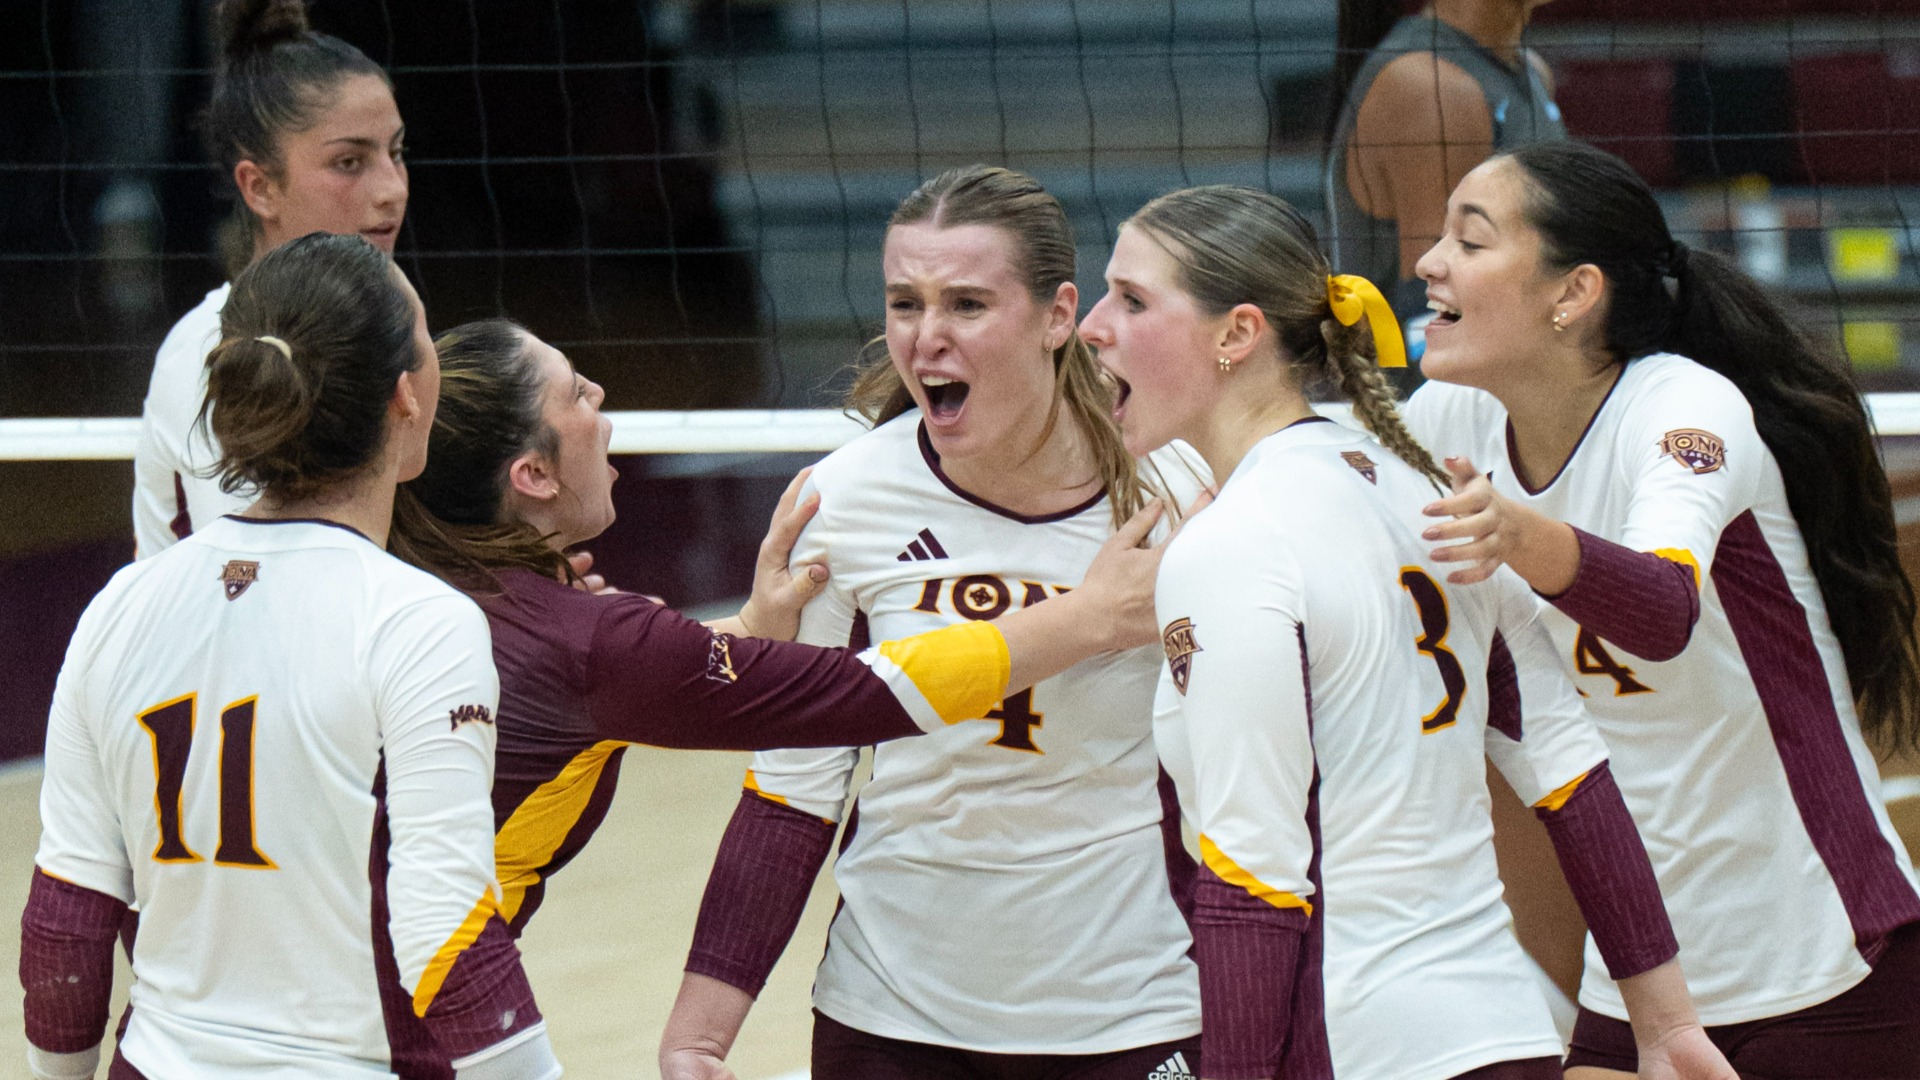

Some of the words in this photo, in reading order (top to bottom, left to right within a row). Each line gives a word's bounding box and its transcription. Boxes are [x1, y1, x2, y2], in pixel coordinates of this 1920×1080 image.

[1663, 434, 1725, 464] IONA
[911, 573, 1074, 621] ION
[1397, 565, 1467, 735] 3
[1574, 624, 1658, 698] 4
[134, 689, 281, 871] 11
